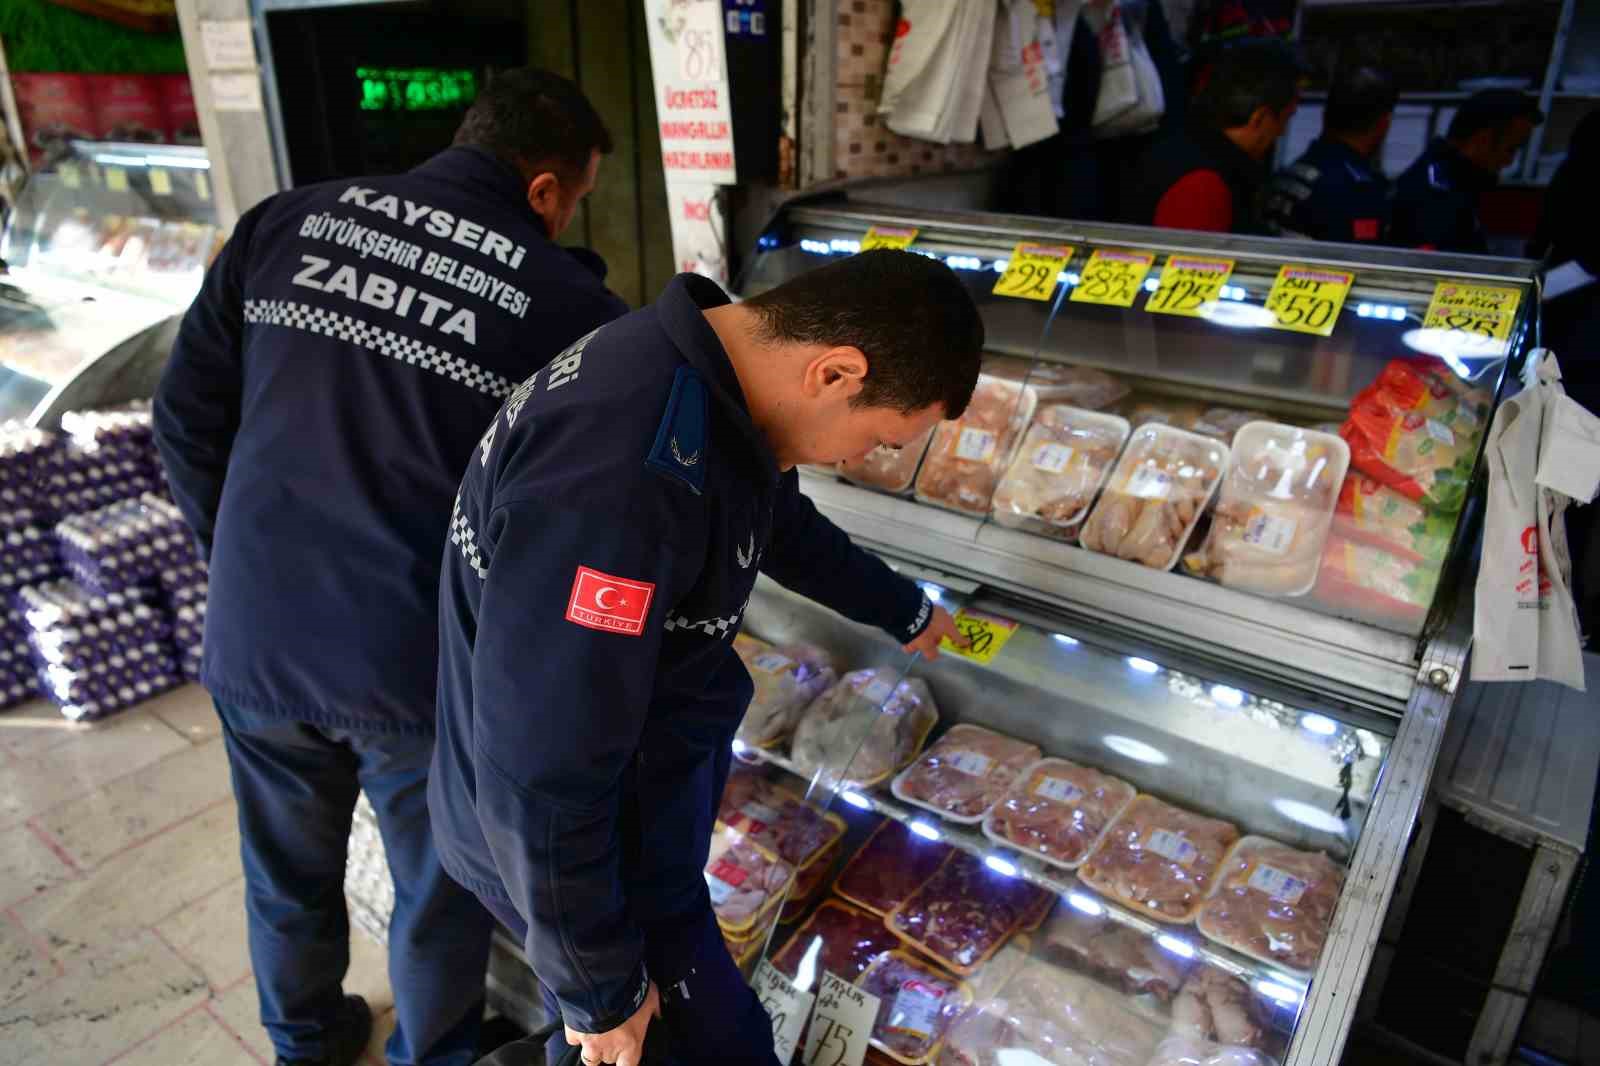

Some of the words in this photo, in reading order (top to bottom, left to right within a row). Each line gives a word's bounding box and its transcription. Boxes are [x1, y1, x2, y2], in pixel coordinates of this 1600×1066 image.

[299, 212, 422, 270] BÜYÜKŞEHİR
[420, 251, 532, 319] BELEDİYESİ
[338, 185, 527, 270] KAYSERİ
[292, 254, 477, 345] ZABITA
[1278, 295, 1334, 328] 50
[810, 1013, 854, 1066] 75
